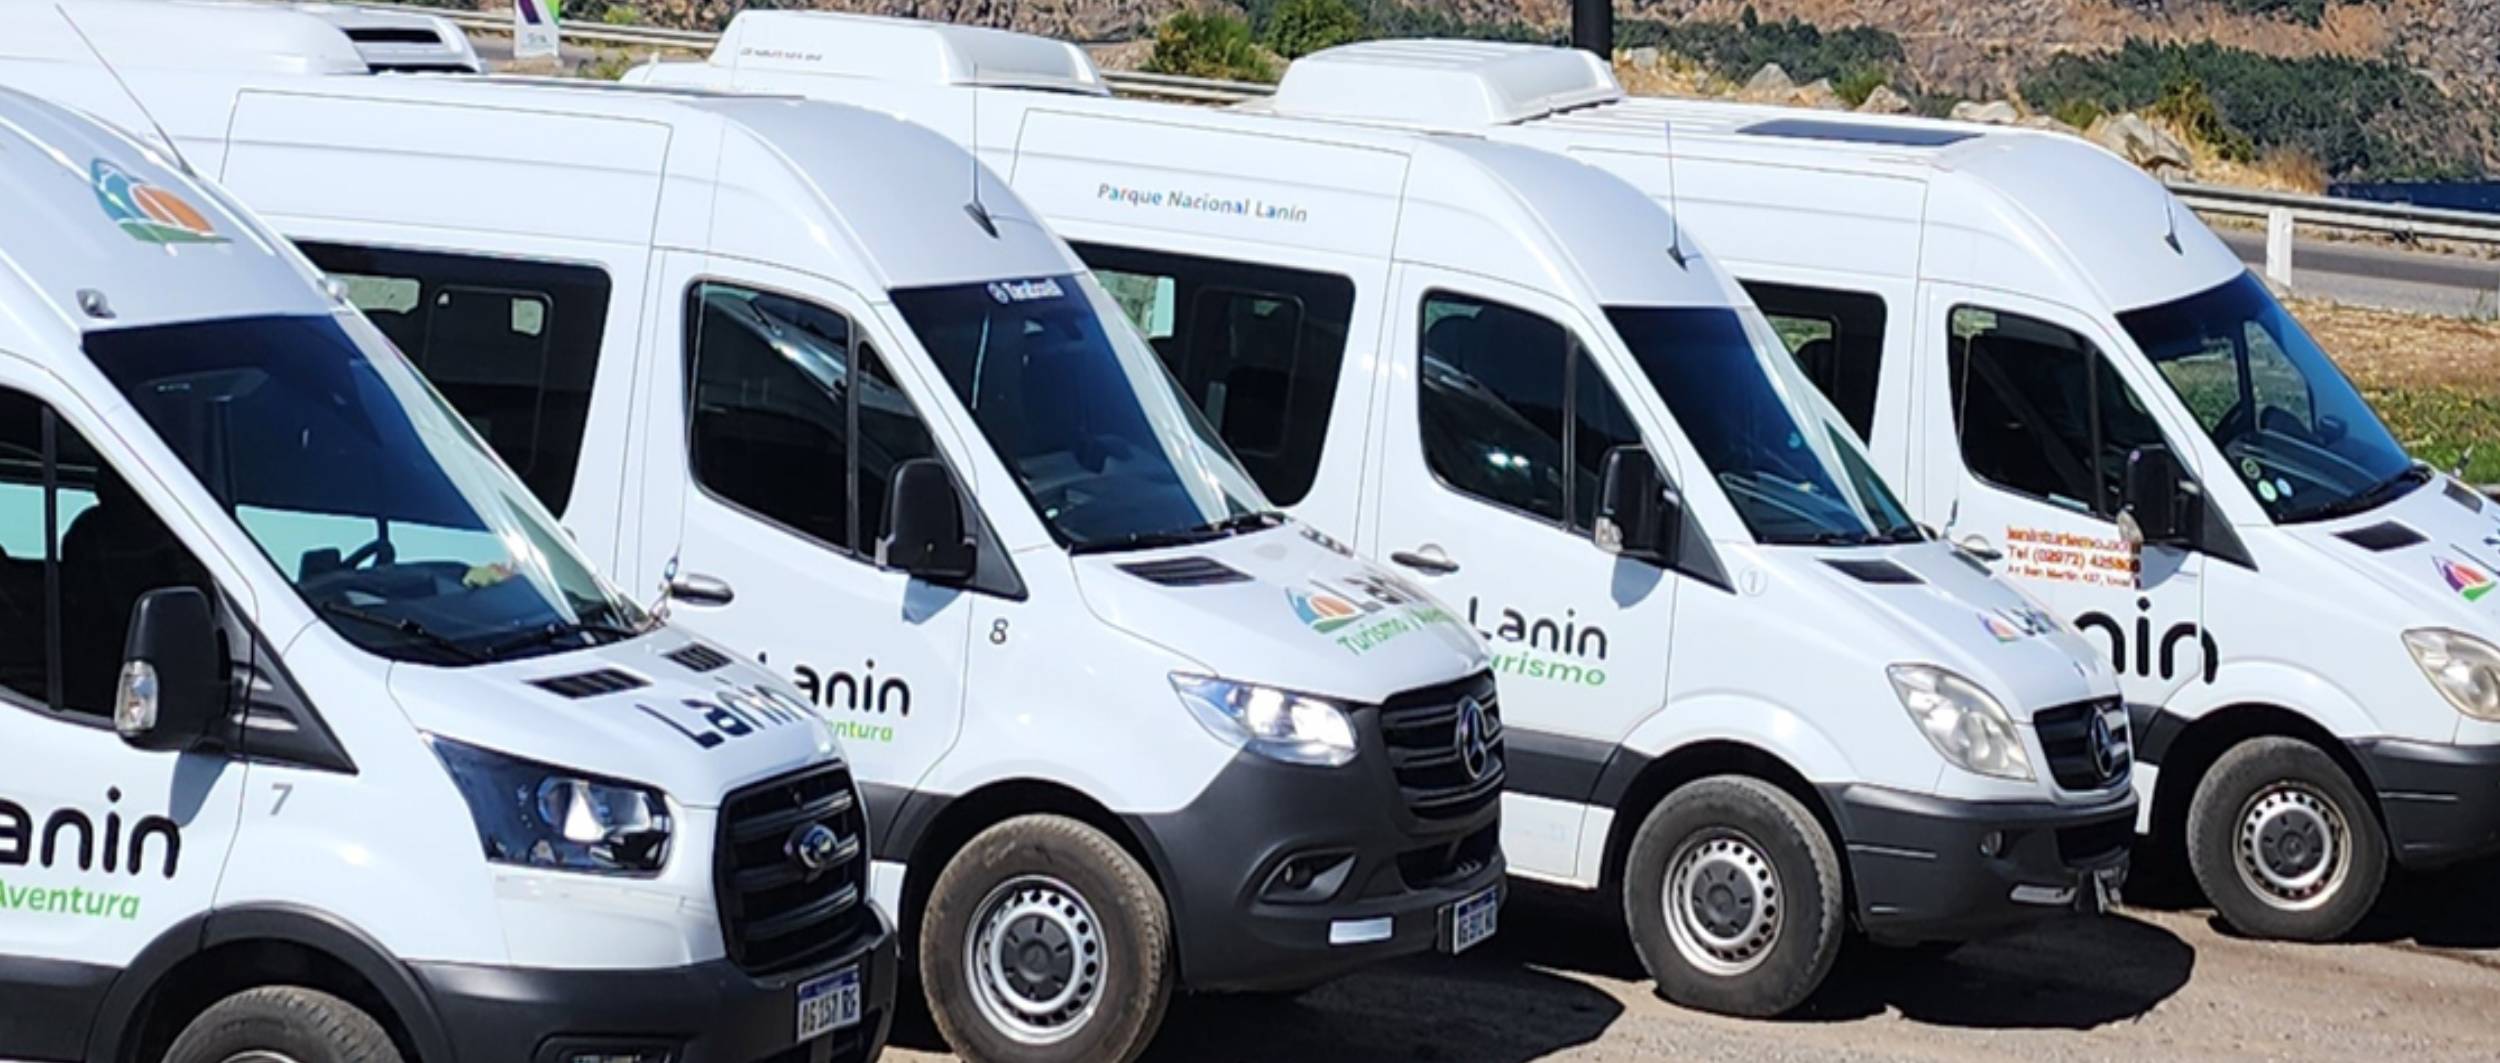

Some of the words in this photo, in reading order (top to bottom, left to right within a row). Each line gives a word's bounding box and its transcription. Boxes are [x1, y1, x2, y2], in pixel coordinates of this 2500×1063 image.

[1097, 183, 1163, 206] Parque
[1167, 190, 1251, 216] Nacional
[989, 617, 1009, 646] 8
[1469, 596, 1607, 660] Lanin
[2073, 596, 2218, 685] nin
[635, 675, 818, 749] Lanin
[758, 652, 910, 717] anin
[270, 782, 293, 816] 7
[0, 786, 181, 880] anin
